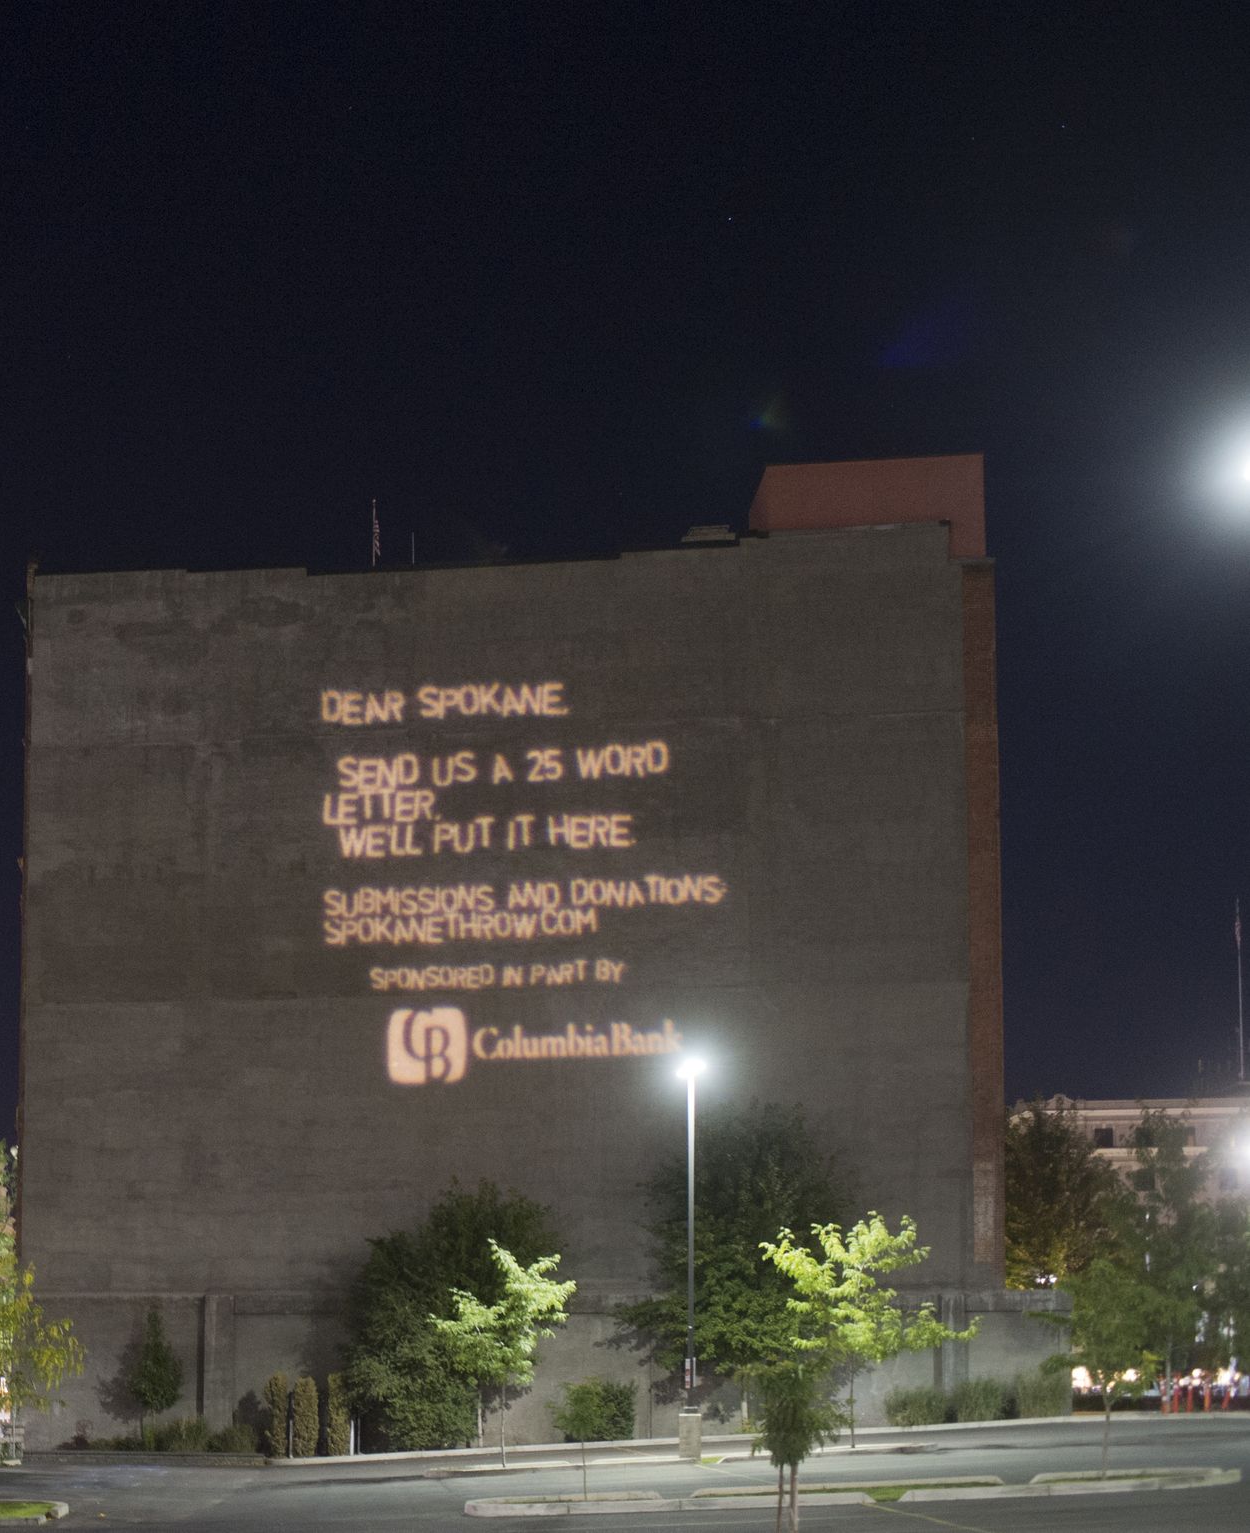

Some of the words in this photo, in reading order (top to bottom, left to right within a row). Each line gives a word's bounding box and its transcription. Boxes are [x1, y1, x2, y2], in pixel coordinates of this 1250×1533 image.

[321, 690, 405, 725] DEAR
[337, 753, 419, 794] SEND
[432, 750, 477, 786] US
[492, 754, 513, 784] A
[526, 748, 564, 782] 25
[576, 740, 669, 779] WORD
[433, 815, 495, 853] PUT
[507, 814, 535, 850] IT
[323, 884, 495, 918] SUBMISSIONS
[507, 881, 561, 910] AND
[369, 964, 494, 991] SPONSORED
[502, 965, 523, 986] IN
[529, 959, 587, 985] PART
[595, 959, 625, 983] BY
[472, 1023, 610, 1060] Columbia
[610, 1017, 683, 1056] Bank
